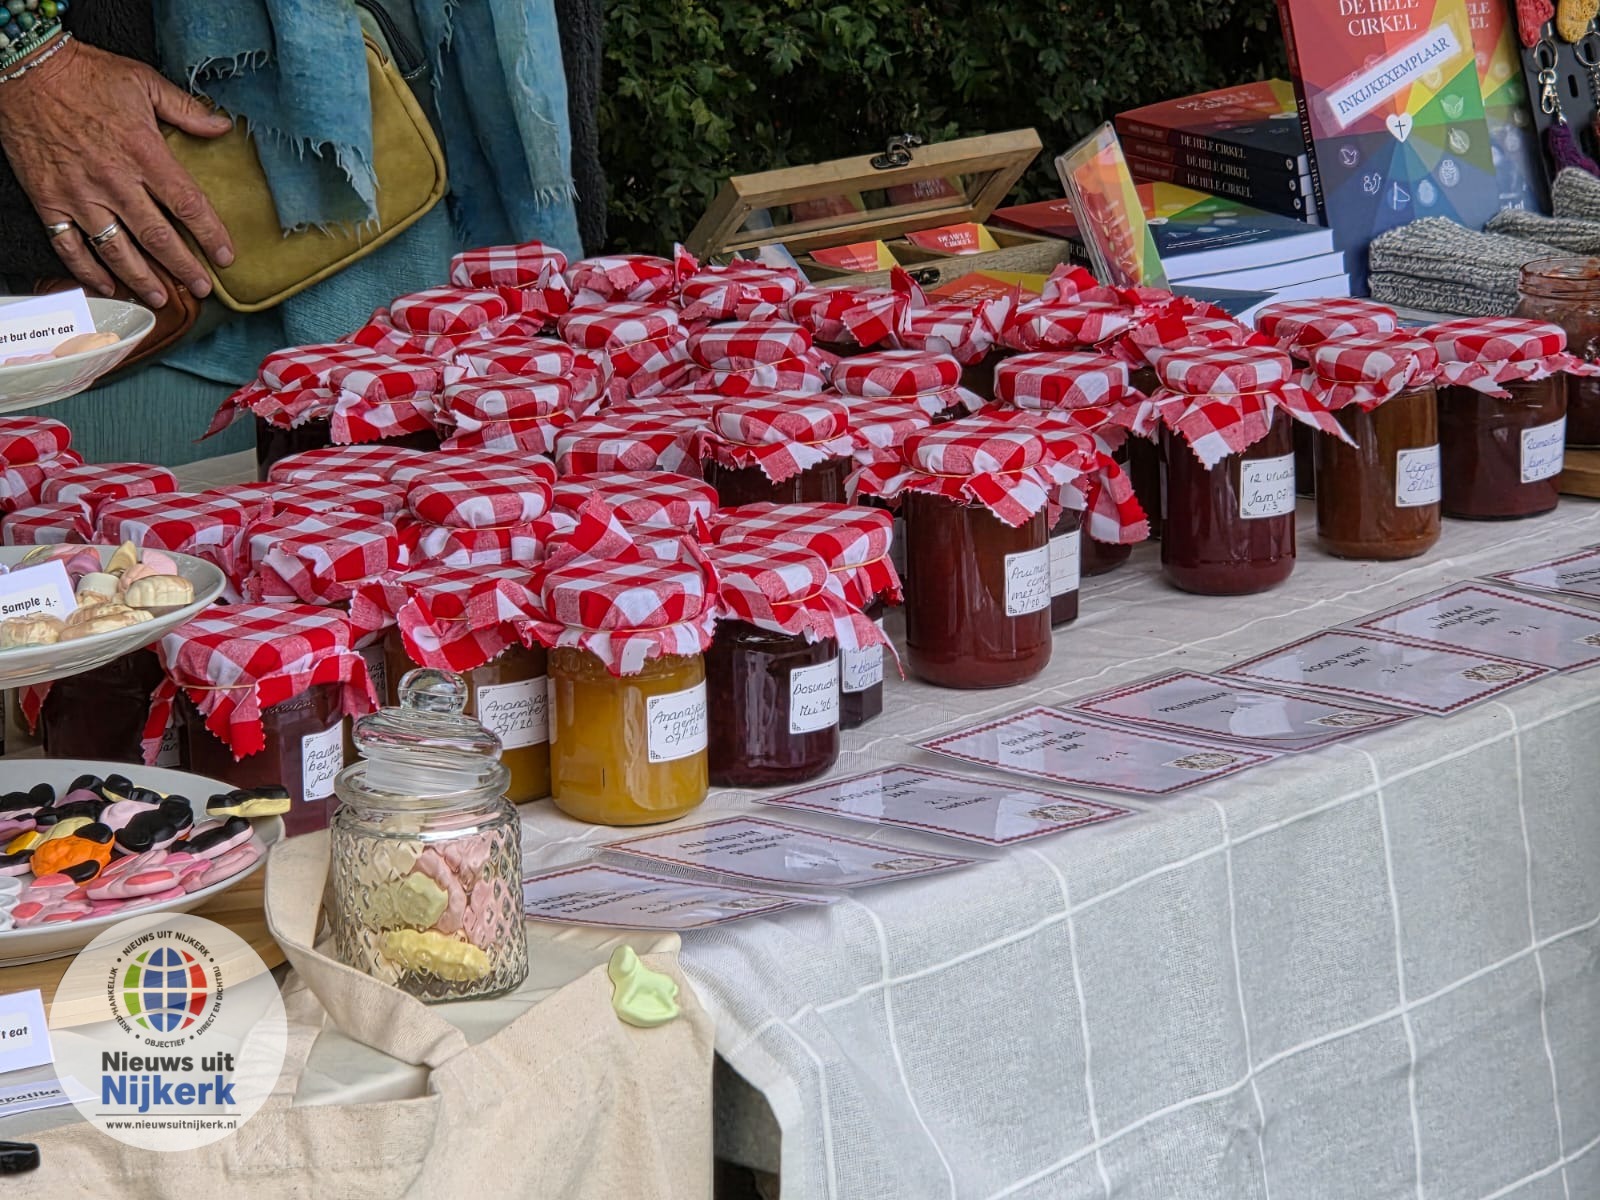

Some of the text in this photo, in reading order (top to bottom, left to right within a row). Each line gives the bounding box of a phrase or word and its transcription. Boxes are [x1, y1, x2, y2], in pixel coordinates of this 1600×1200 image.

[1338, 0, 1419, 16] DE HELE
[1347, 13, 1418, 37] CIRKEL
[1336, 36, 1451, 115] INKIJKEXEMPLAAR
[1215, 142, 1247, 159] CIRKEL
[10, 332, 27, 342] but
[29, 327, 55, 339] don't
[57, 324, 74, 335] eat
[1473, 616, 1501, 626] JAM
[1302, 646, 1371, 673] ROOD FRUIT
[1343, 657, 1372, 668] JAM
[1001, 729, 1054, 747] BRAMEN
[1056, 743, 1085, 752] JAM
[9, 1026, 28, 1038] eat
